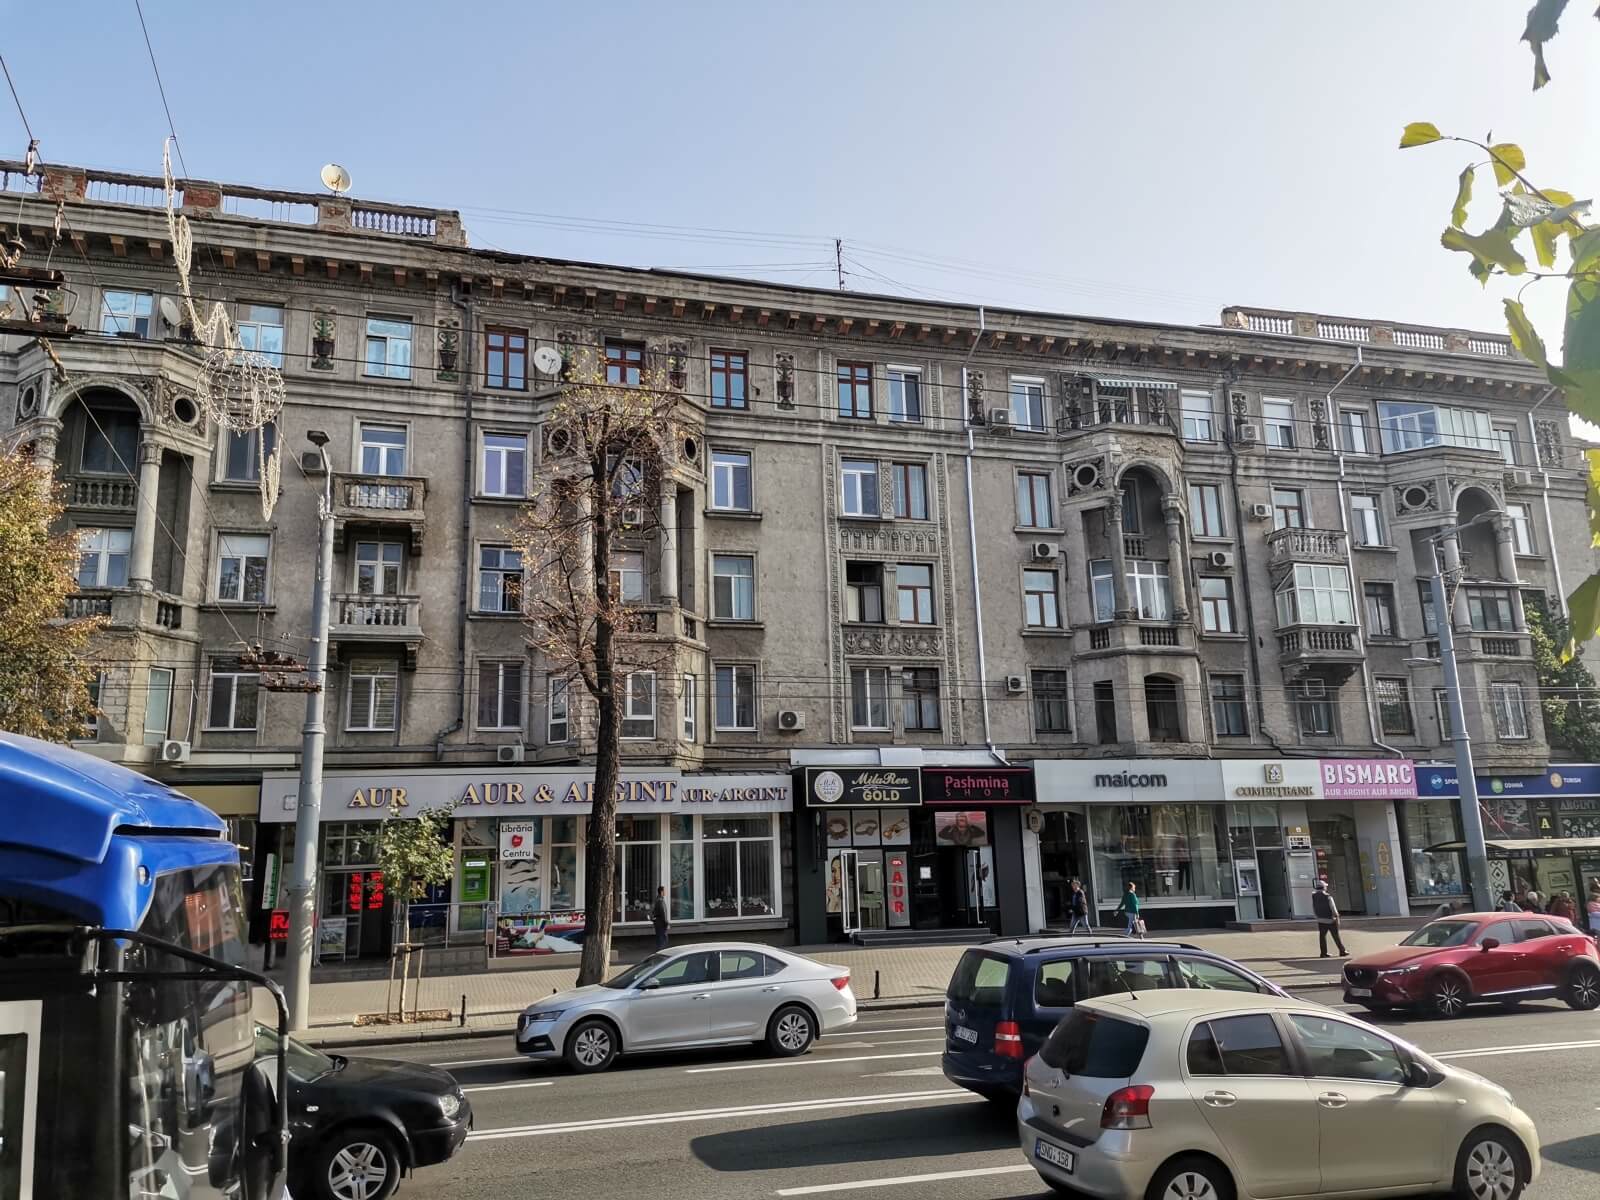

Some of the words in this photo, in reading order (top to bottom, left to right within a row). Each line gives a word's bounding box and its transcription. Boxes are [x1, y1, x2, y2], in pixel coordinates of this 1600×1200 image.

[851, 772, 909, 785] MilaRen
[1095, 769, 1167, 788] maicom
[1324, 764, 1412, 784] BISMARC
[945, 776, 1009, 789] Pashmina
[348, 787, 409, 808] AUR
[461, 783, 525, 805] AUR
[534, 783, 554, 803] &
[862, 790, 900, 801] GOLD
[945, 789, 1009, 797] SHOP
[1325, 788, 1341, 796] AUR
[1344, 788, 1369, 796] ARGINT
[1371, 788, 1387, 796] AUR
[501, 823, 533, 833] Librăria
[502, 849, 531, 858] Centru
[892, 871, 904, 913] AUR
[1057, 1151, 1070, 1168] 158
